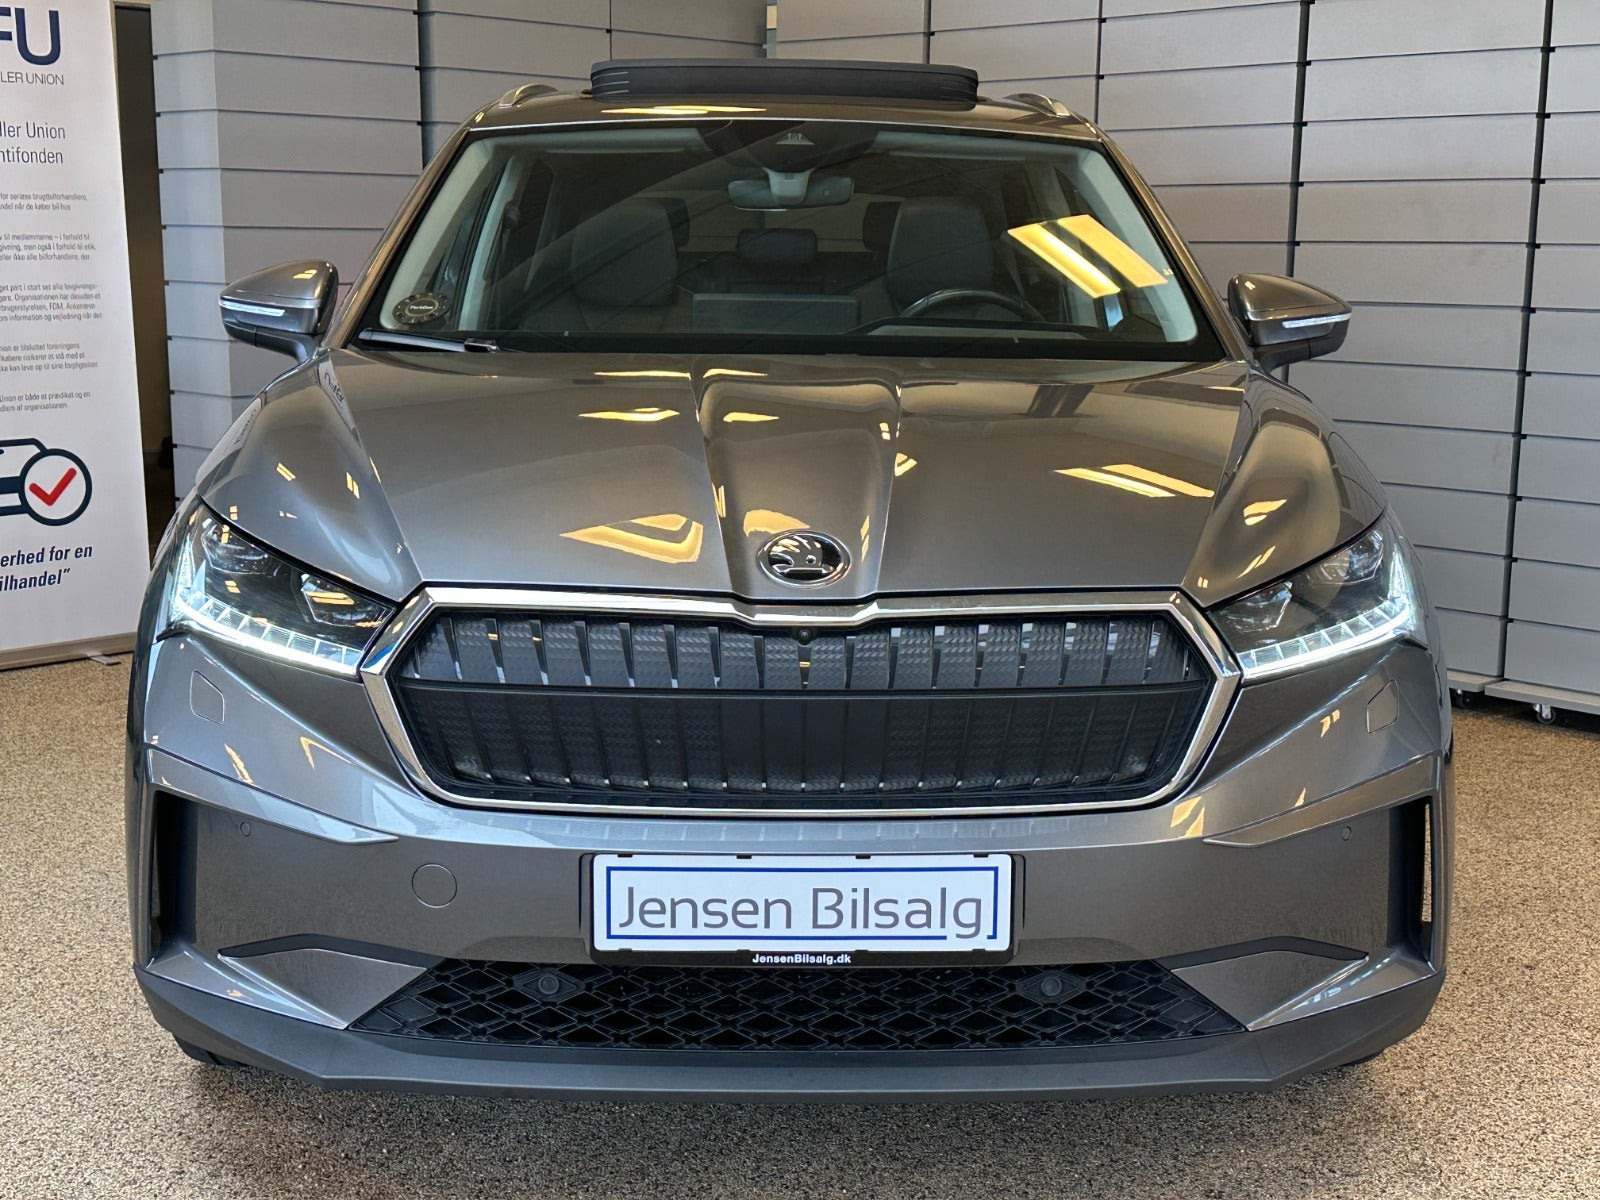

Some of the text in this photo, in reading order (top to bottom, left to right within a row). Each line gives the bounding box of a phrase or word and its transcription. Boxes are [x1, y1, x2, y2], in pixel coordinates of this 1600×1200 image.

[26, 72, 64, 85] UNION
[0, 121, 66, 139] ler Union
[0, 146, 64, 164] ntifonden
[0, 545, 93, 567] erhed for en
[618, 886, 982, 939] Jensen Bilsalg
[752, 953, 852, 966] JensenBilsalg.dk
